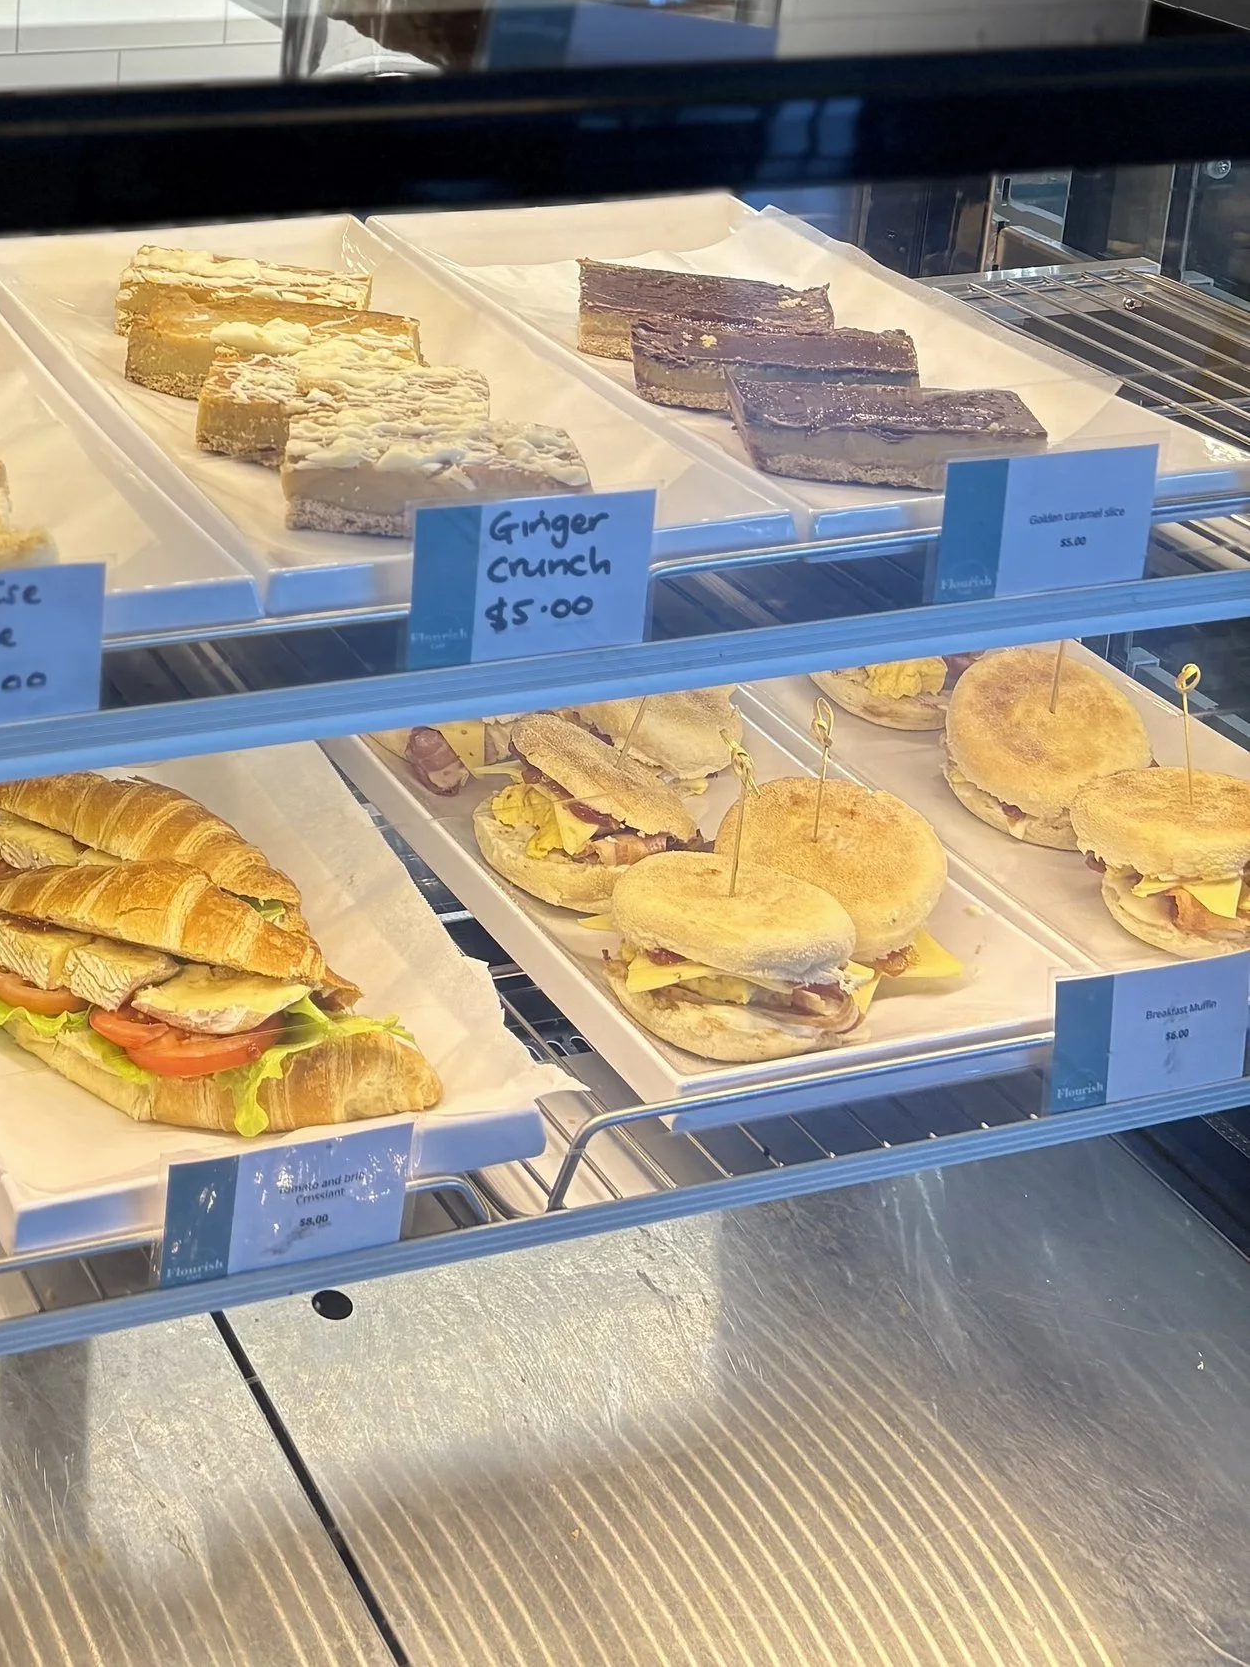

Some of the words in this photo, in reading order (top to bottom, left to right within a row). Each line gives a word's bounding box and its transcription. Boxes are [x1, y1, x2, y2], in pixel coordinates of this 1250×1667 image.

[1029, 513, 1063, 525] Golden
[1064, 507, 1103, 521] caramel
[1103, 506, 1125, 518] slice
[489, 509, 610, 549] Ginger
[1145, 1006, 1188, 1020] Breakfast
[1190, 999, 1217, 1013] Muffin
[1165, 1028, 1189, 1041] $6.00
[1057, 1081, 1104, 1099] Flourish
[321, 1175, 342, 1188] and
[166, 1259, 223, 1279] Flourish
